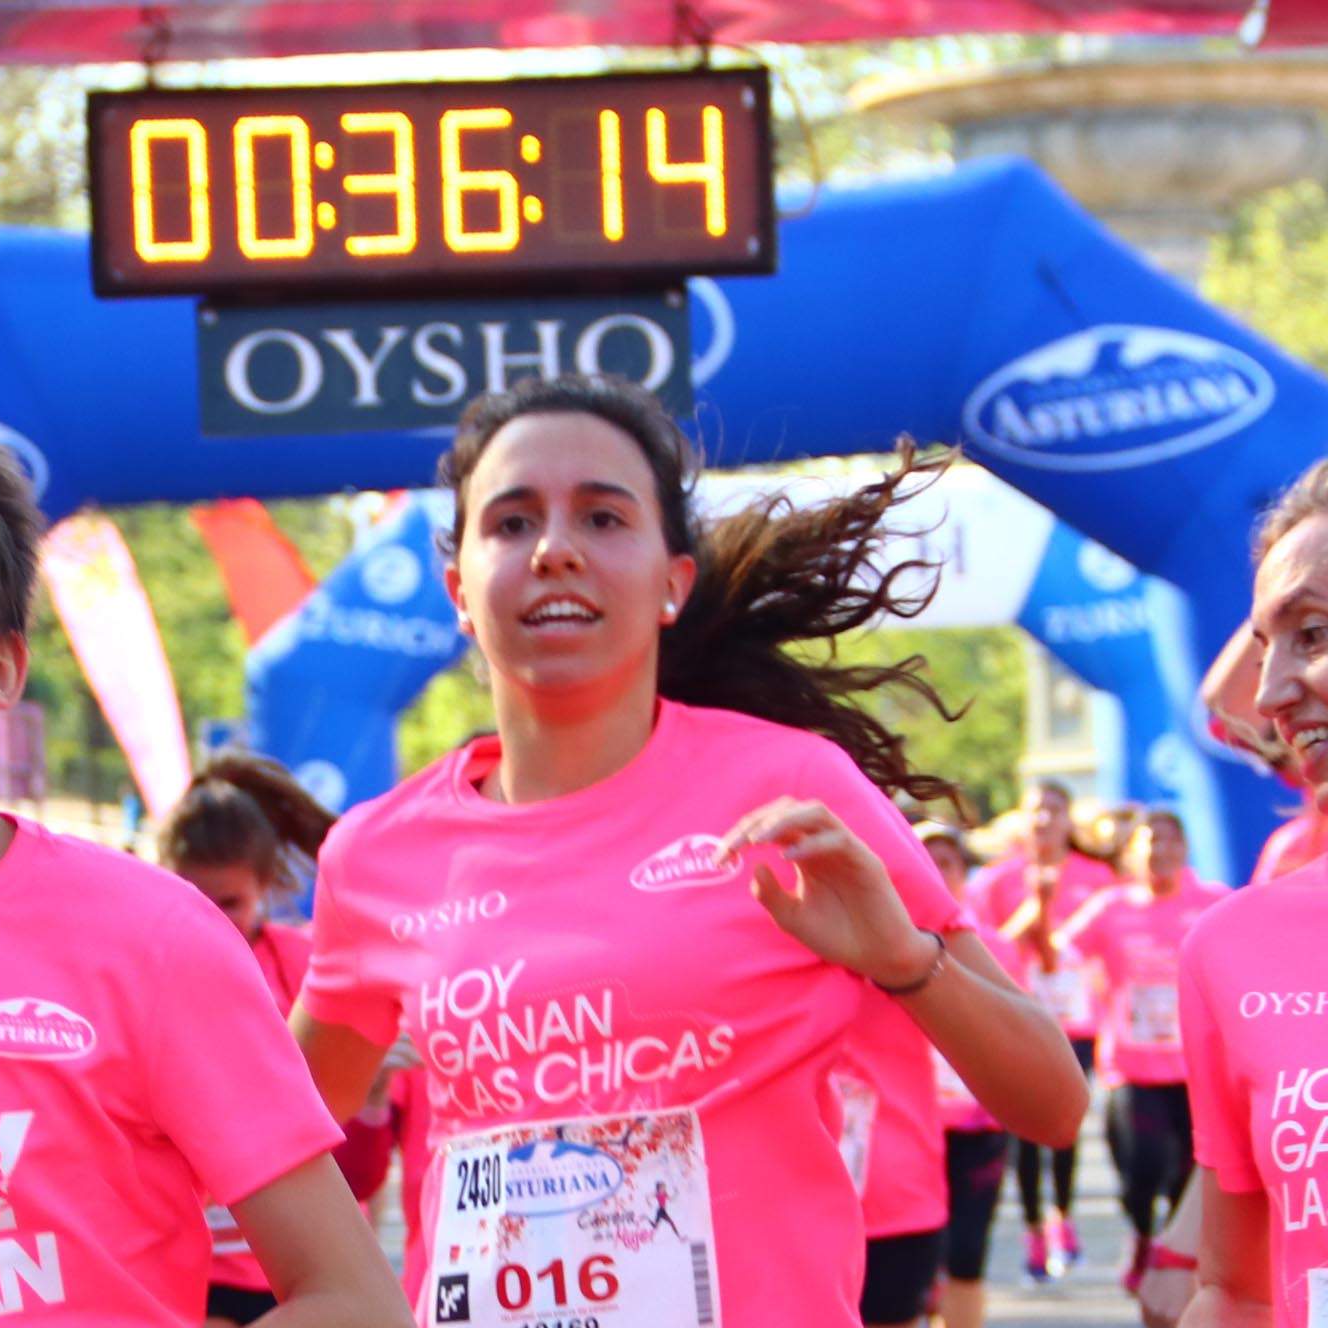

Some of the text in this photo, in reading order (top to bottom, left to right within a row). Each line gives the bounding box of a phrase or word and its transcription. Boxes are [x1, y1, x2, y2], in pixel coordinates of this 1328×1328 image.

[129, 104, 727, 263] 00:36:14
[224, 313, 675, 414] OYSHO
[390, 889, 507, 943] OYSHO
[420, 957, 526, 1031] HOY
[427, 989, 614, 1077] GANAN
[445, 1024, 737, 1119] LAS CHICAS
[457, 1153, 502, 1212] 2430
[495, 1253, 620, 1312] 016
